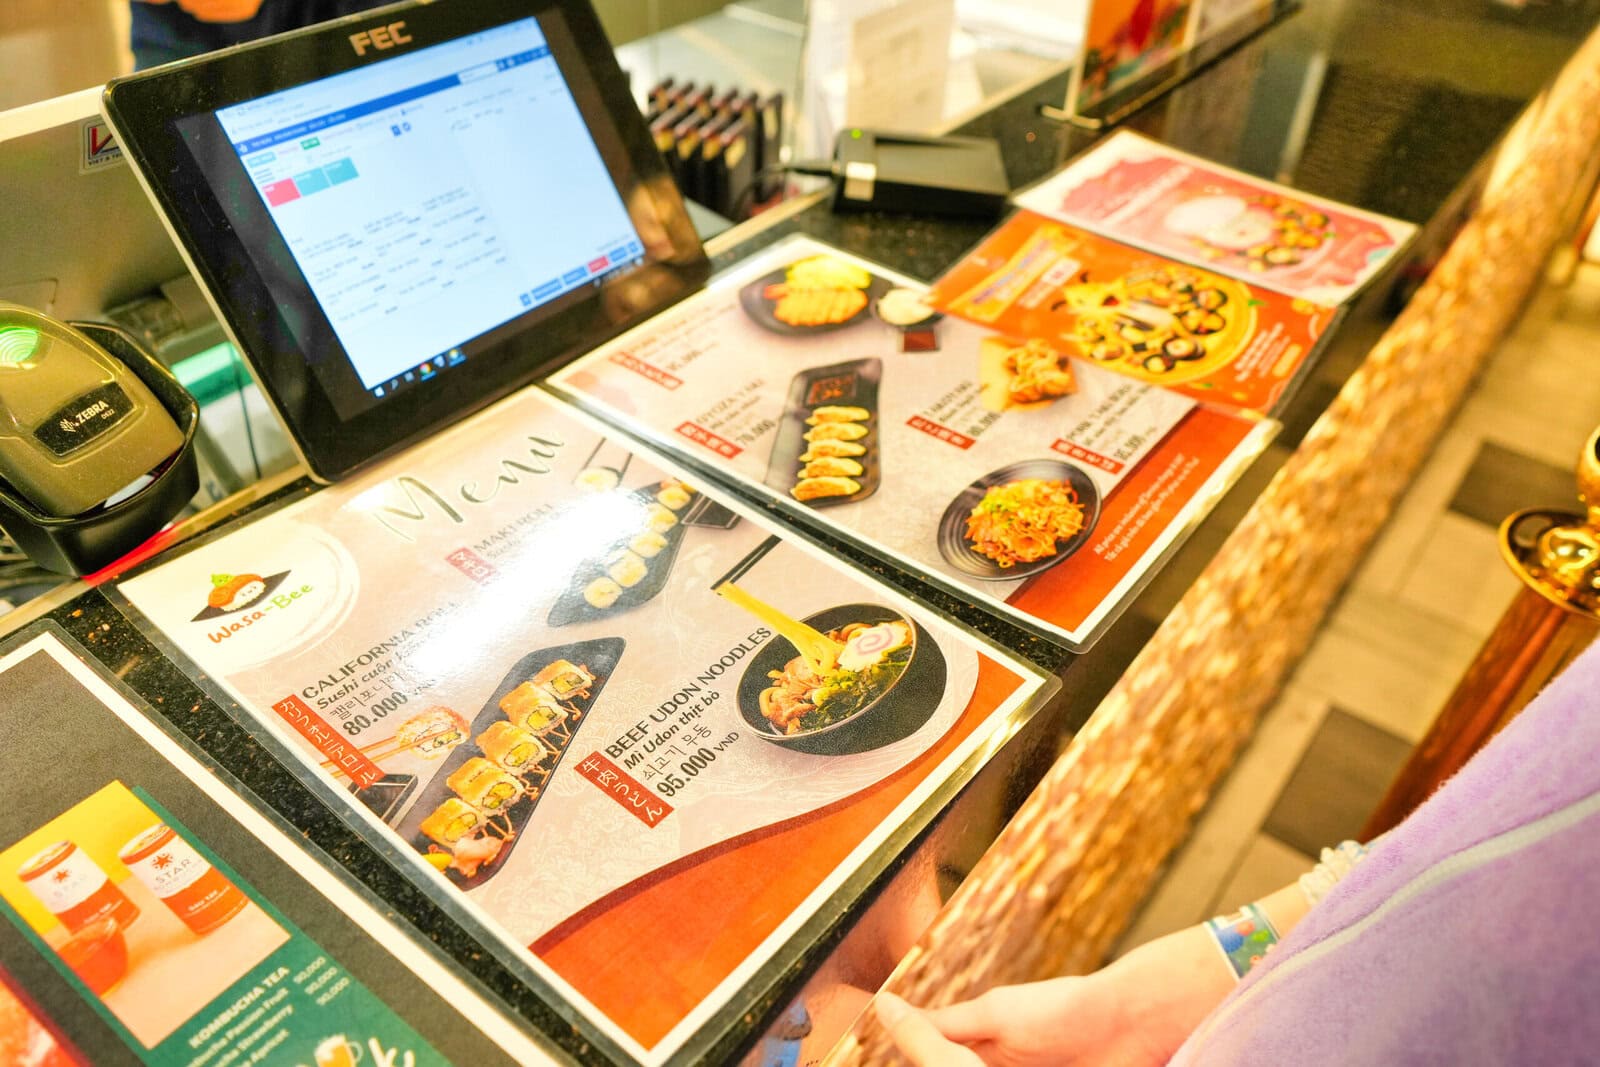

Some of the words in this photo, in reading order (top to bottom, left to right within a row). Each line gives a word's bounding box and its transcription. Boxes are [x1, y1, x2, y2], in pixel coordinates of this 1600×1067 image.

[348, 20, 413, 56] FEC
[75, 400, 109, 424] ZEBRA
[373, 434, 565, 541] Menu
[208, 585, 313, 643] Wasa-Bee
[302, 630, 414, 699] CALIFORNIA
[317, 679, 359, 710] Sushi
[605, 720, 651, 760] BEEF
[650, 682, 702, 724] UDON
[697, 626, 771, 686] NOODLES
[279, 700, 376, 785] カリフォルニアロール
[342, 691, 408, 736] 80.000
[624, 750, 645, 770] Mì
[643, 723, 680, 754] Udon
[678, 704, 704, 727] thịt
[705, 690, 720, 707] bò
[642, 744, 687, 781] 쇠고기
[681, 723, 712, 747] 우동
[656, 747, 716, 797] 95.000
[714, 731, 740, 753] VND
[582, 758, 663, 821] 牛肉うどん
[155, 858, 191, 883] STAR
[188, 985, 265, 1048] KOMBUCHA
[262, 966, 290, 987] TEA
